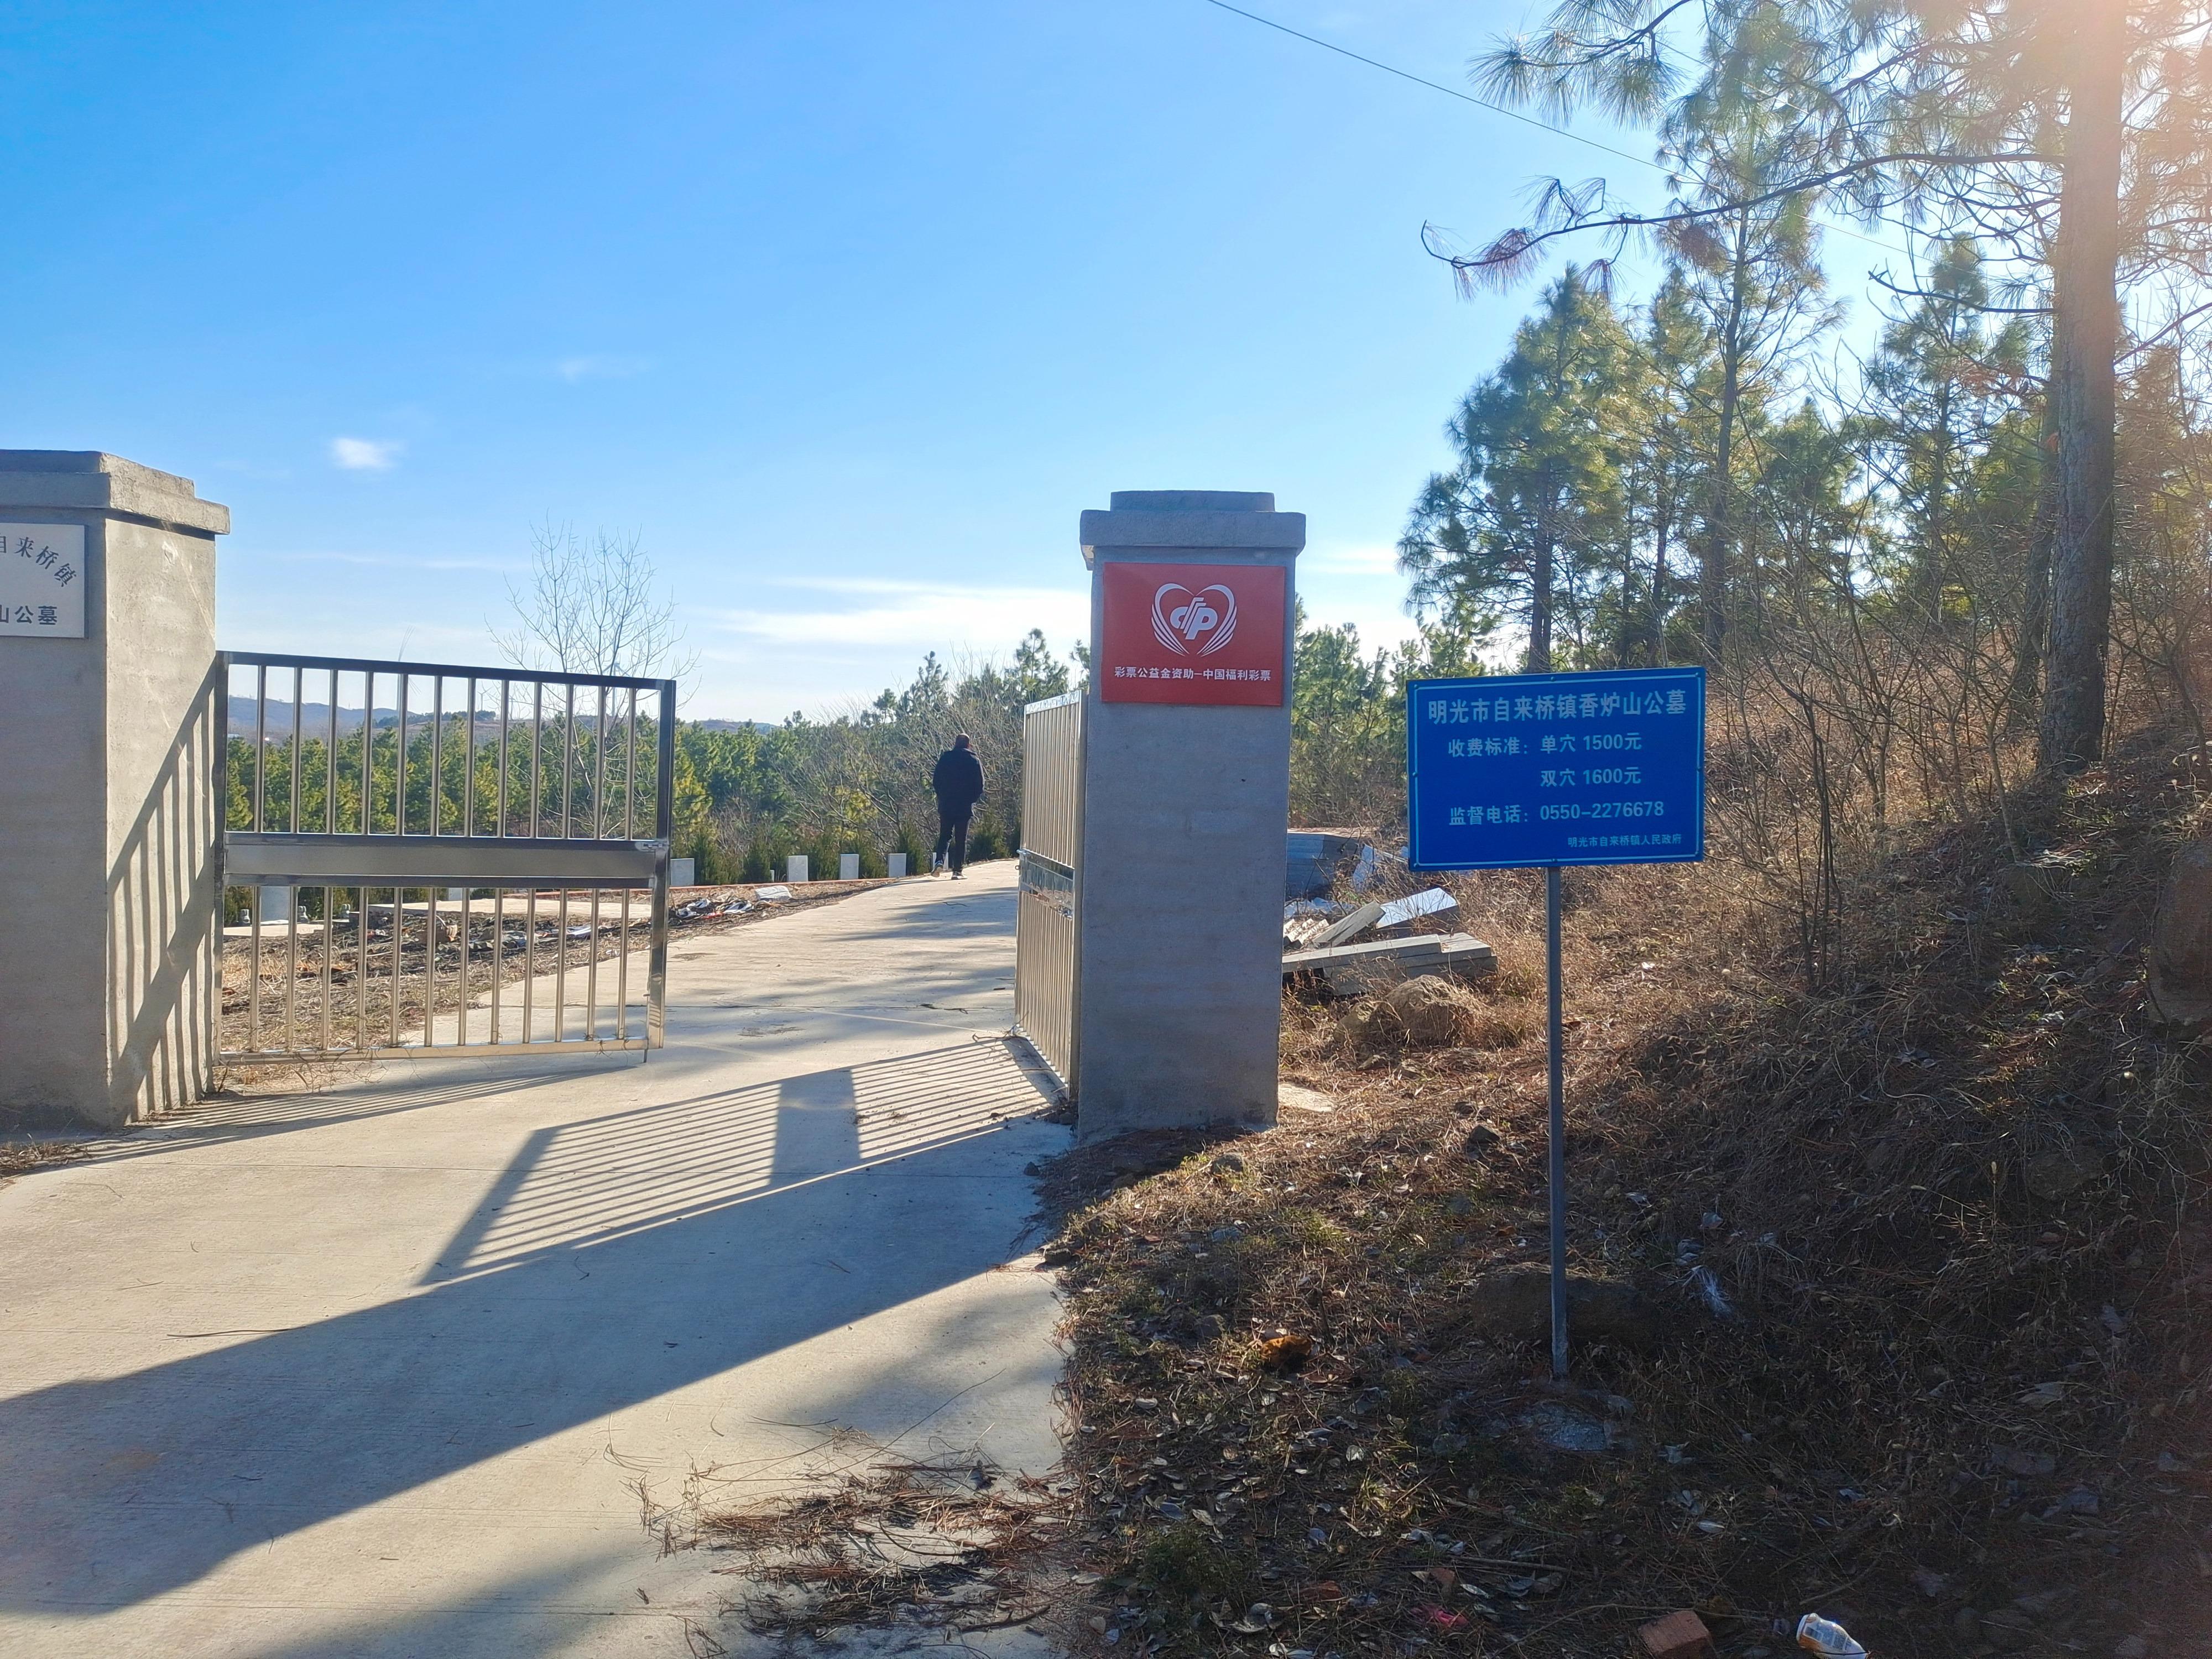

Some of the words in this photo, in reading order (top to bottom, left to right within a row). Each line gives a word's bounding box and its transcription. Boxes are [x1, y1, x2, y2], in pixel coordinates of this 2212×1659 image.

[1428, 689, 1686, 725] 明光市自来桥镇香炉山公墓
[1583, 732, 1642, 751] 1500元
[1583, 767, 1641, 785] 1600元
[1568, 833, 1682, 848] 明光市自来桥镇人民政府
